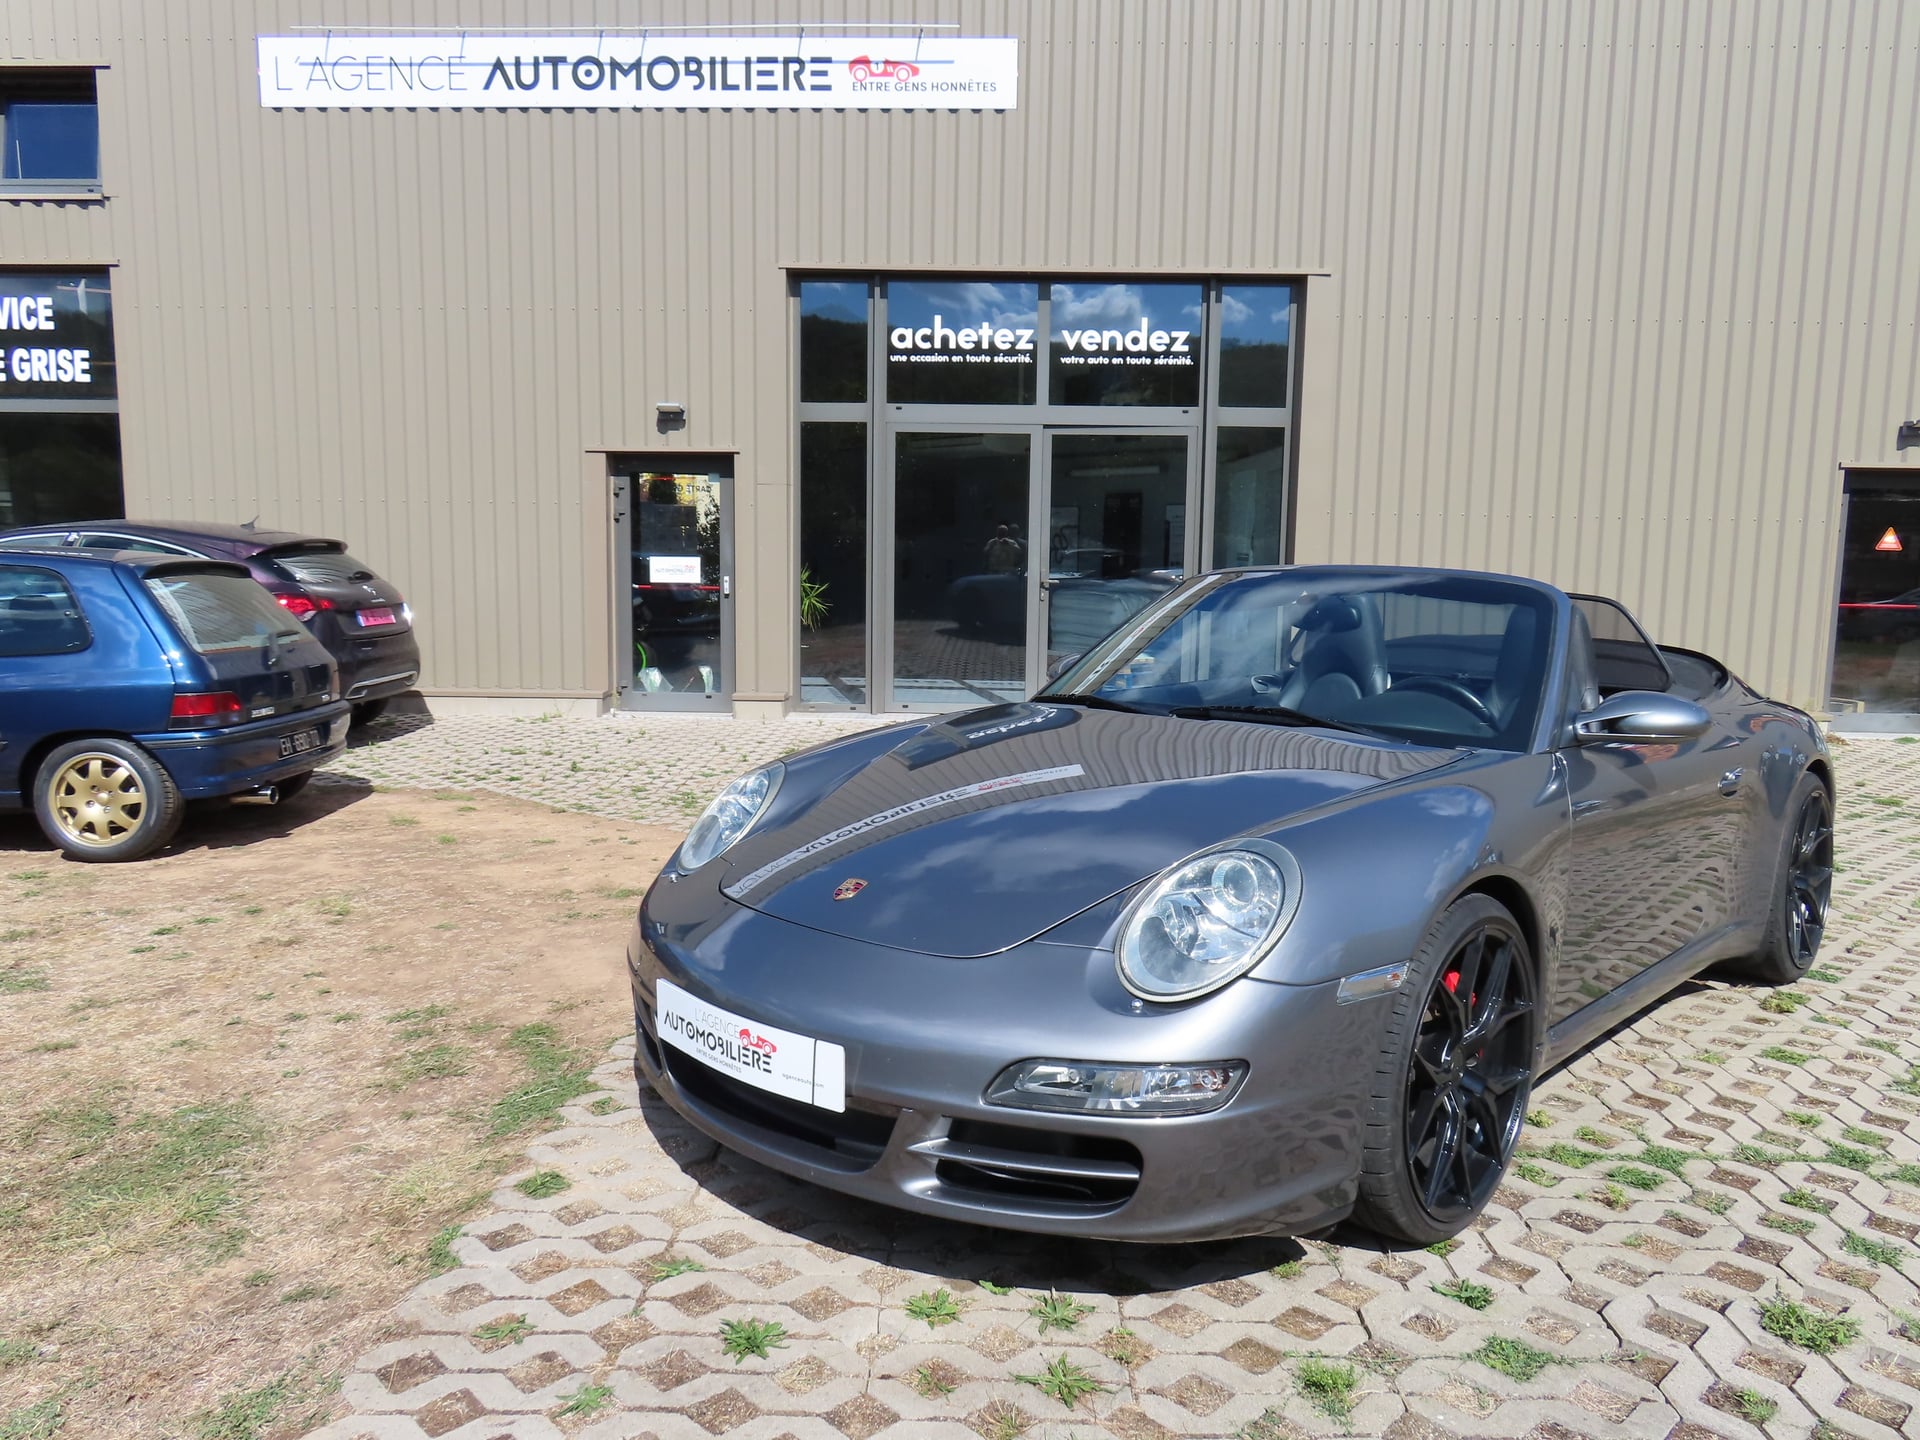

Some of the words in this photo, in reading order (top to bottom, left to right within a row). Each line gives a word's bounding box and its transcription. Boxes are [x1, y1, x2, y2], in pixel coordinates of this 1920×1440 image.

[274, 55, 468, 92] L'AGENCE
[483, 55, 833, 92] AUTOMOBILIERE
[852, 81, 891, 92] ENTRE
[894, 81, 928, 92] GENS
[931, 78, 997, 92] HONNÊTES
[890, 314, 1034, 350] achetez
[1061, 317, 1190, 352] vendez
[12, 348, 91, 383] GRISE
[890, 354, 908, 362] une
[910, 352, 949, 362] occasion
[952, 355, 963, 363] en
[966, 353, 991, 363] toute
[994, 352, 1033, 363] sécurité.
[1060, 355, 1085, 364] votre
[1087, 356, 1109, 365] auto
[1111, 357, 1124, 365] en
[1126, 355, 1151, 365] toute
[1154, 354, 1194, 366] sérénité.
[694, 1008, 740, 1040] L'AGENCE
[663, 1009, 772, 1074] AUTOMOBILIERE
[782, 1073, 825, 1088] agenceautocom
